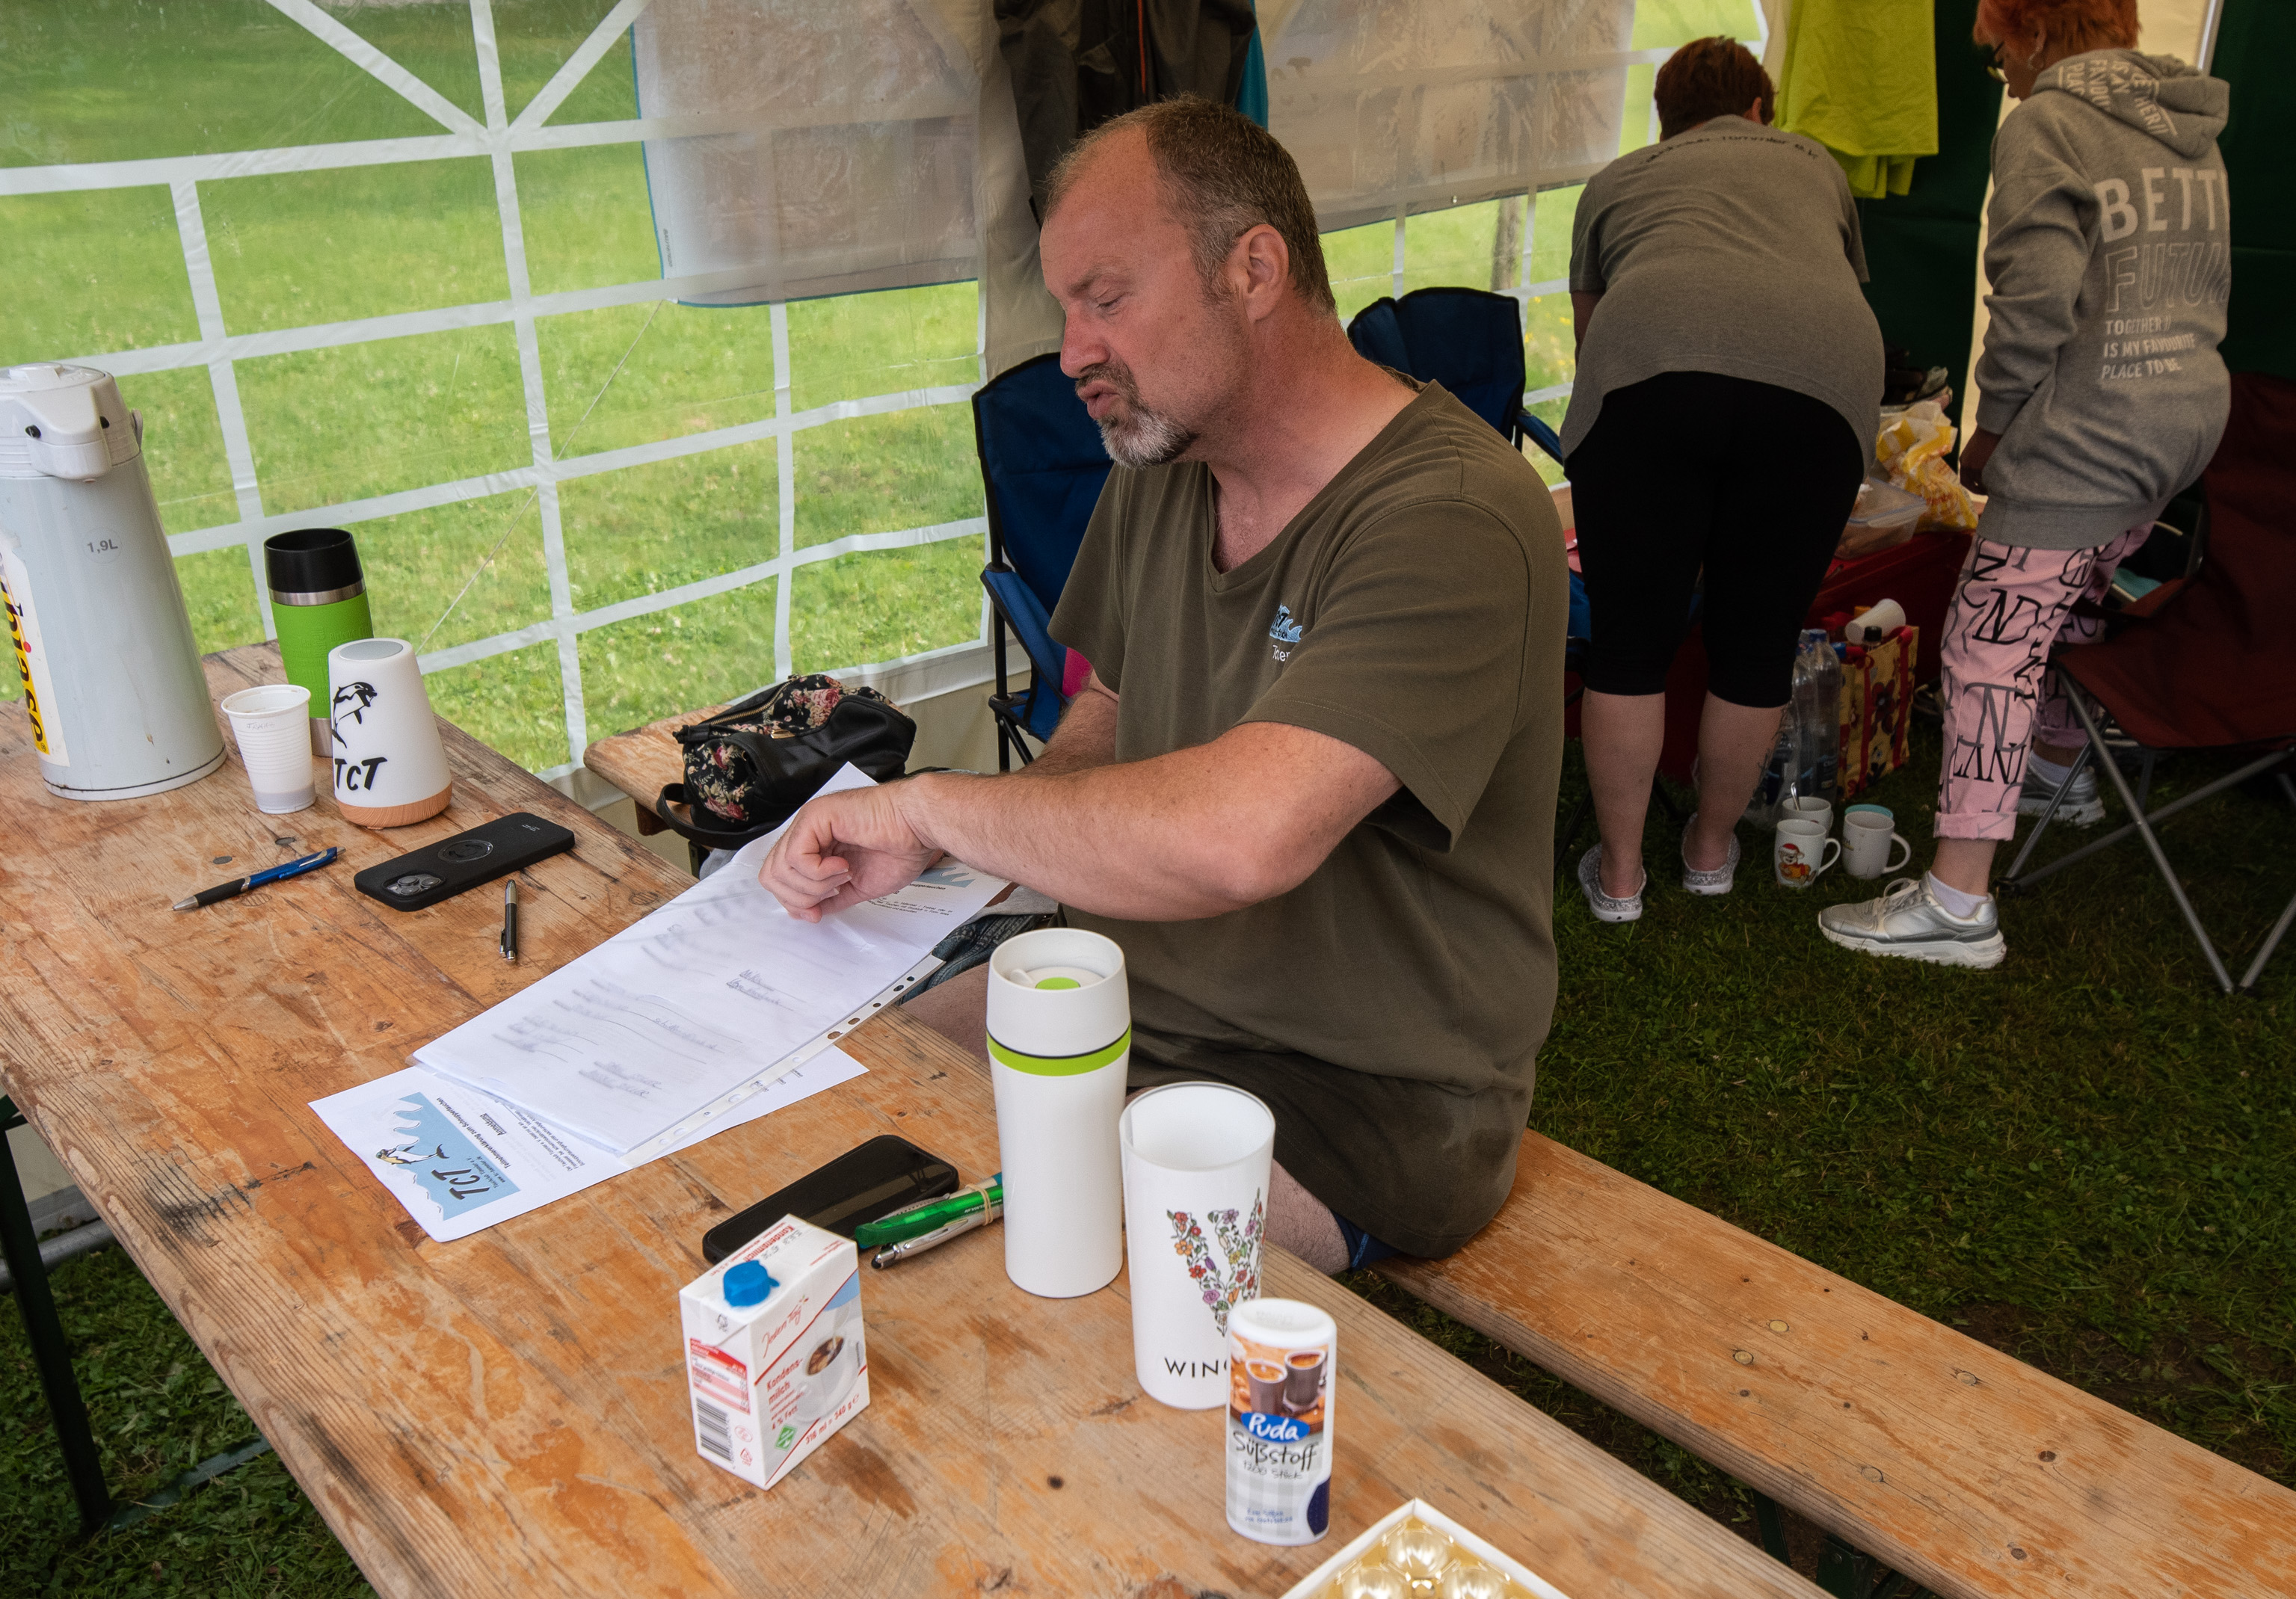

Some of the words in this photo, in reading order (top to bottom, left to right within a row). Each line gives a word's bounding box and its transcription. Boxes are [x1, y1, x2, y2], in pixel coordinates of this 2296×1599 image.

[2105, 317, 2162, 336] TOGETHER
[2103, 342, 2119, 359] IS
[2122, 340, 2140, 358] MY
[2143, 333, 2196, 357] FAVOURITE
[2100, 362, 2143, 381] PLACE
[2146, 360, 2164, 375] TO
[87, 539, 118, 554] 1,9L
[333, 757, 387, 791] TCT
[435, 1097, 470, 1128] Schnuppertauchen
[479, 1112, 506, 1136] Anmeldung
[471, 1133, 511, 1169] Teilnehmererklärung
[766, 1358, 804, 1392] Kondens-
[769, 1381, 790, 1405] milch
[1249, 1413, 1300, 1441] Puda
[1233, 1429, 1320, 1473] Süßstoff
